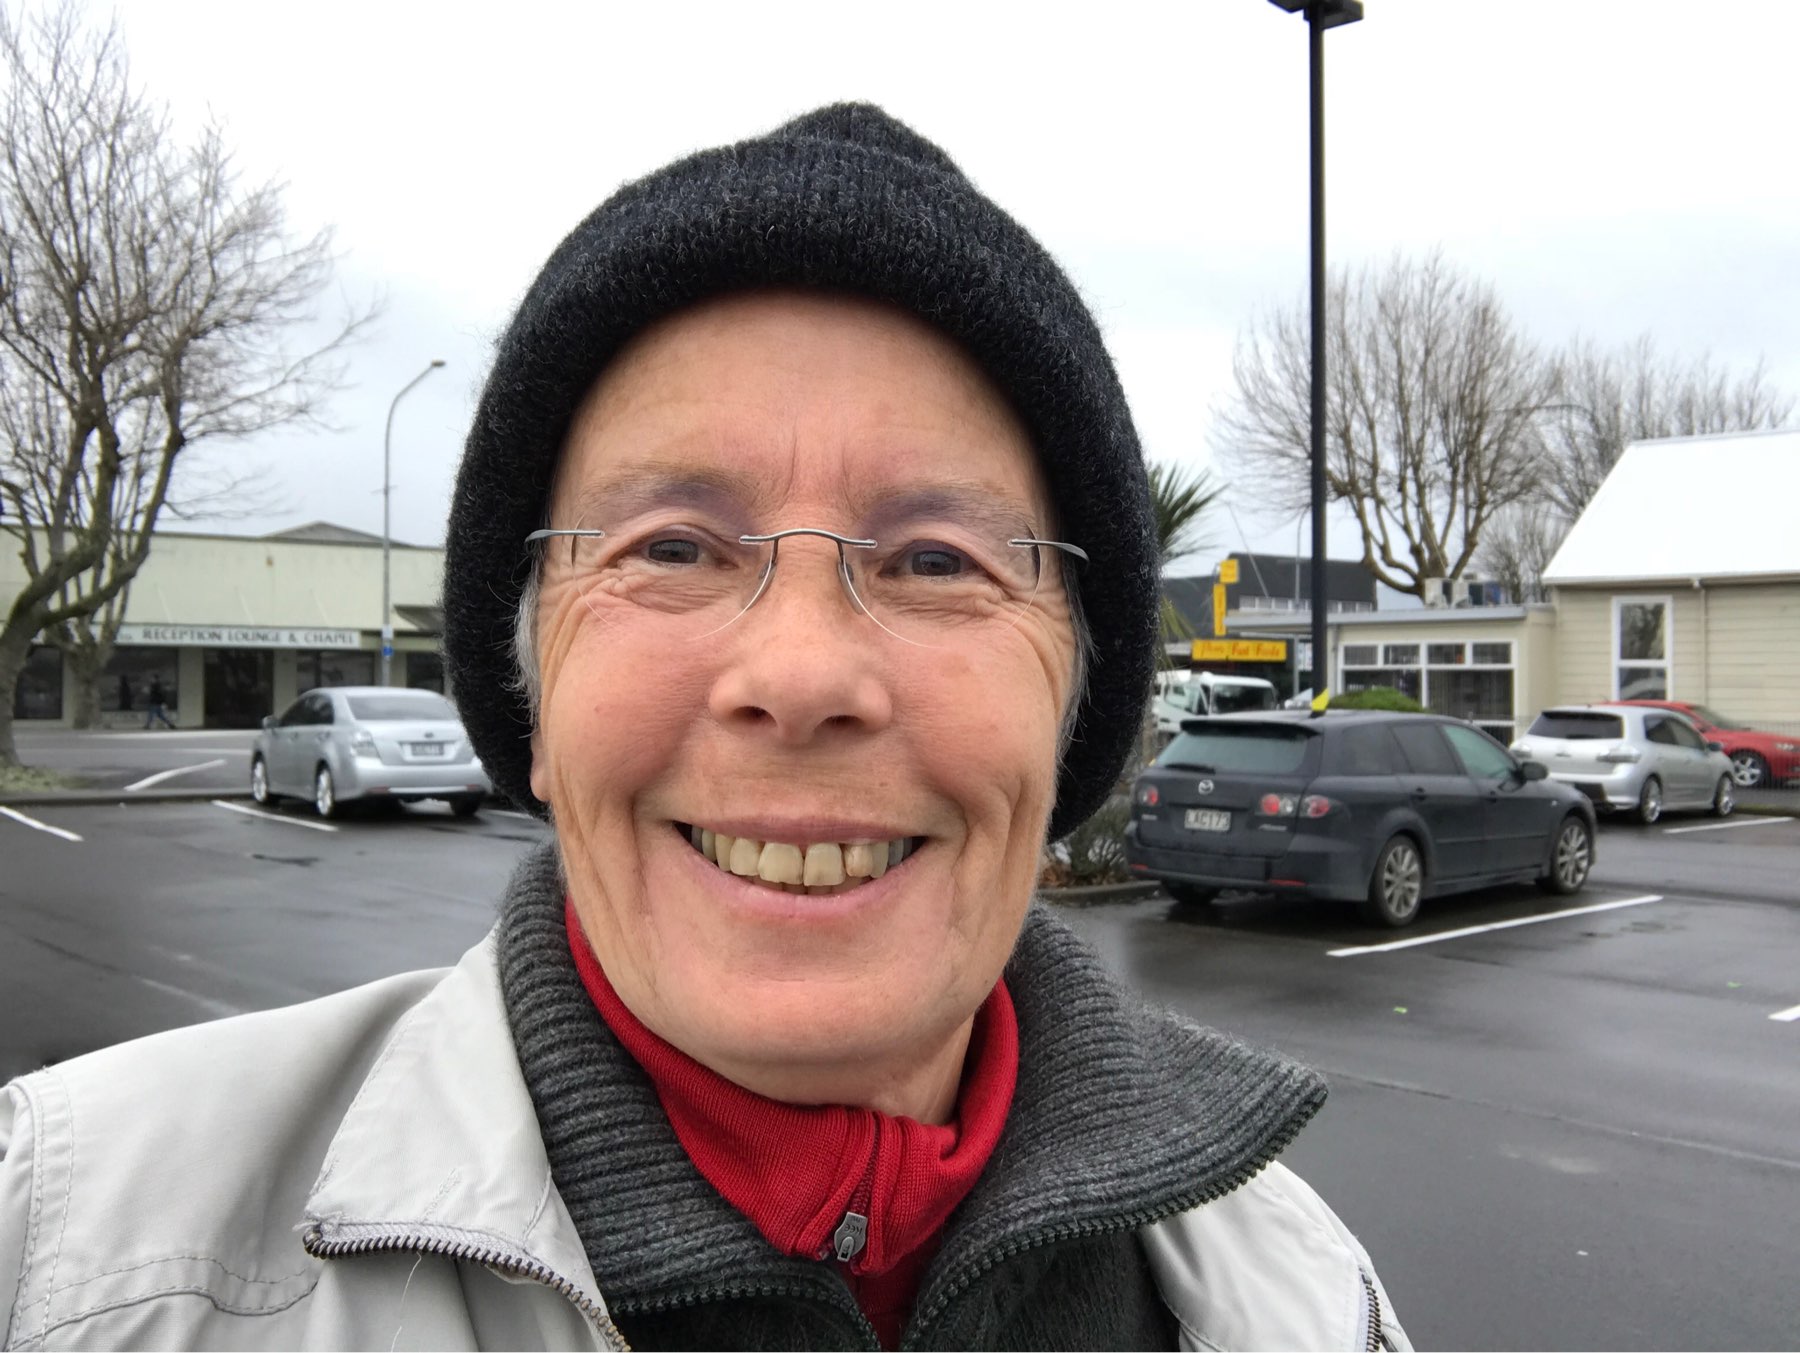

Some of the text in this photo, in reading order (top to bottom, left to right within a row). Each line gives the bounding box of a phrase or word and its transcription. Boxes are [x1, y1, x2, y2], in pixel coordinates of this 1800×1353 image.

[142, 627, 222, 642] RECEPTION
[227, 629, 281, 643] LOUNGE
[288, 632, 297, 643] &
[304, 631, 355, 645] CHAPEL
